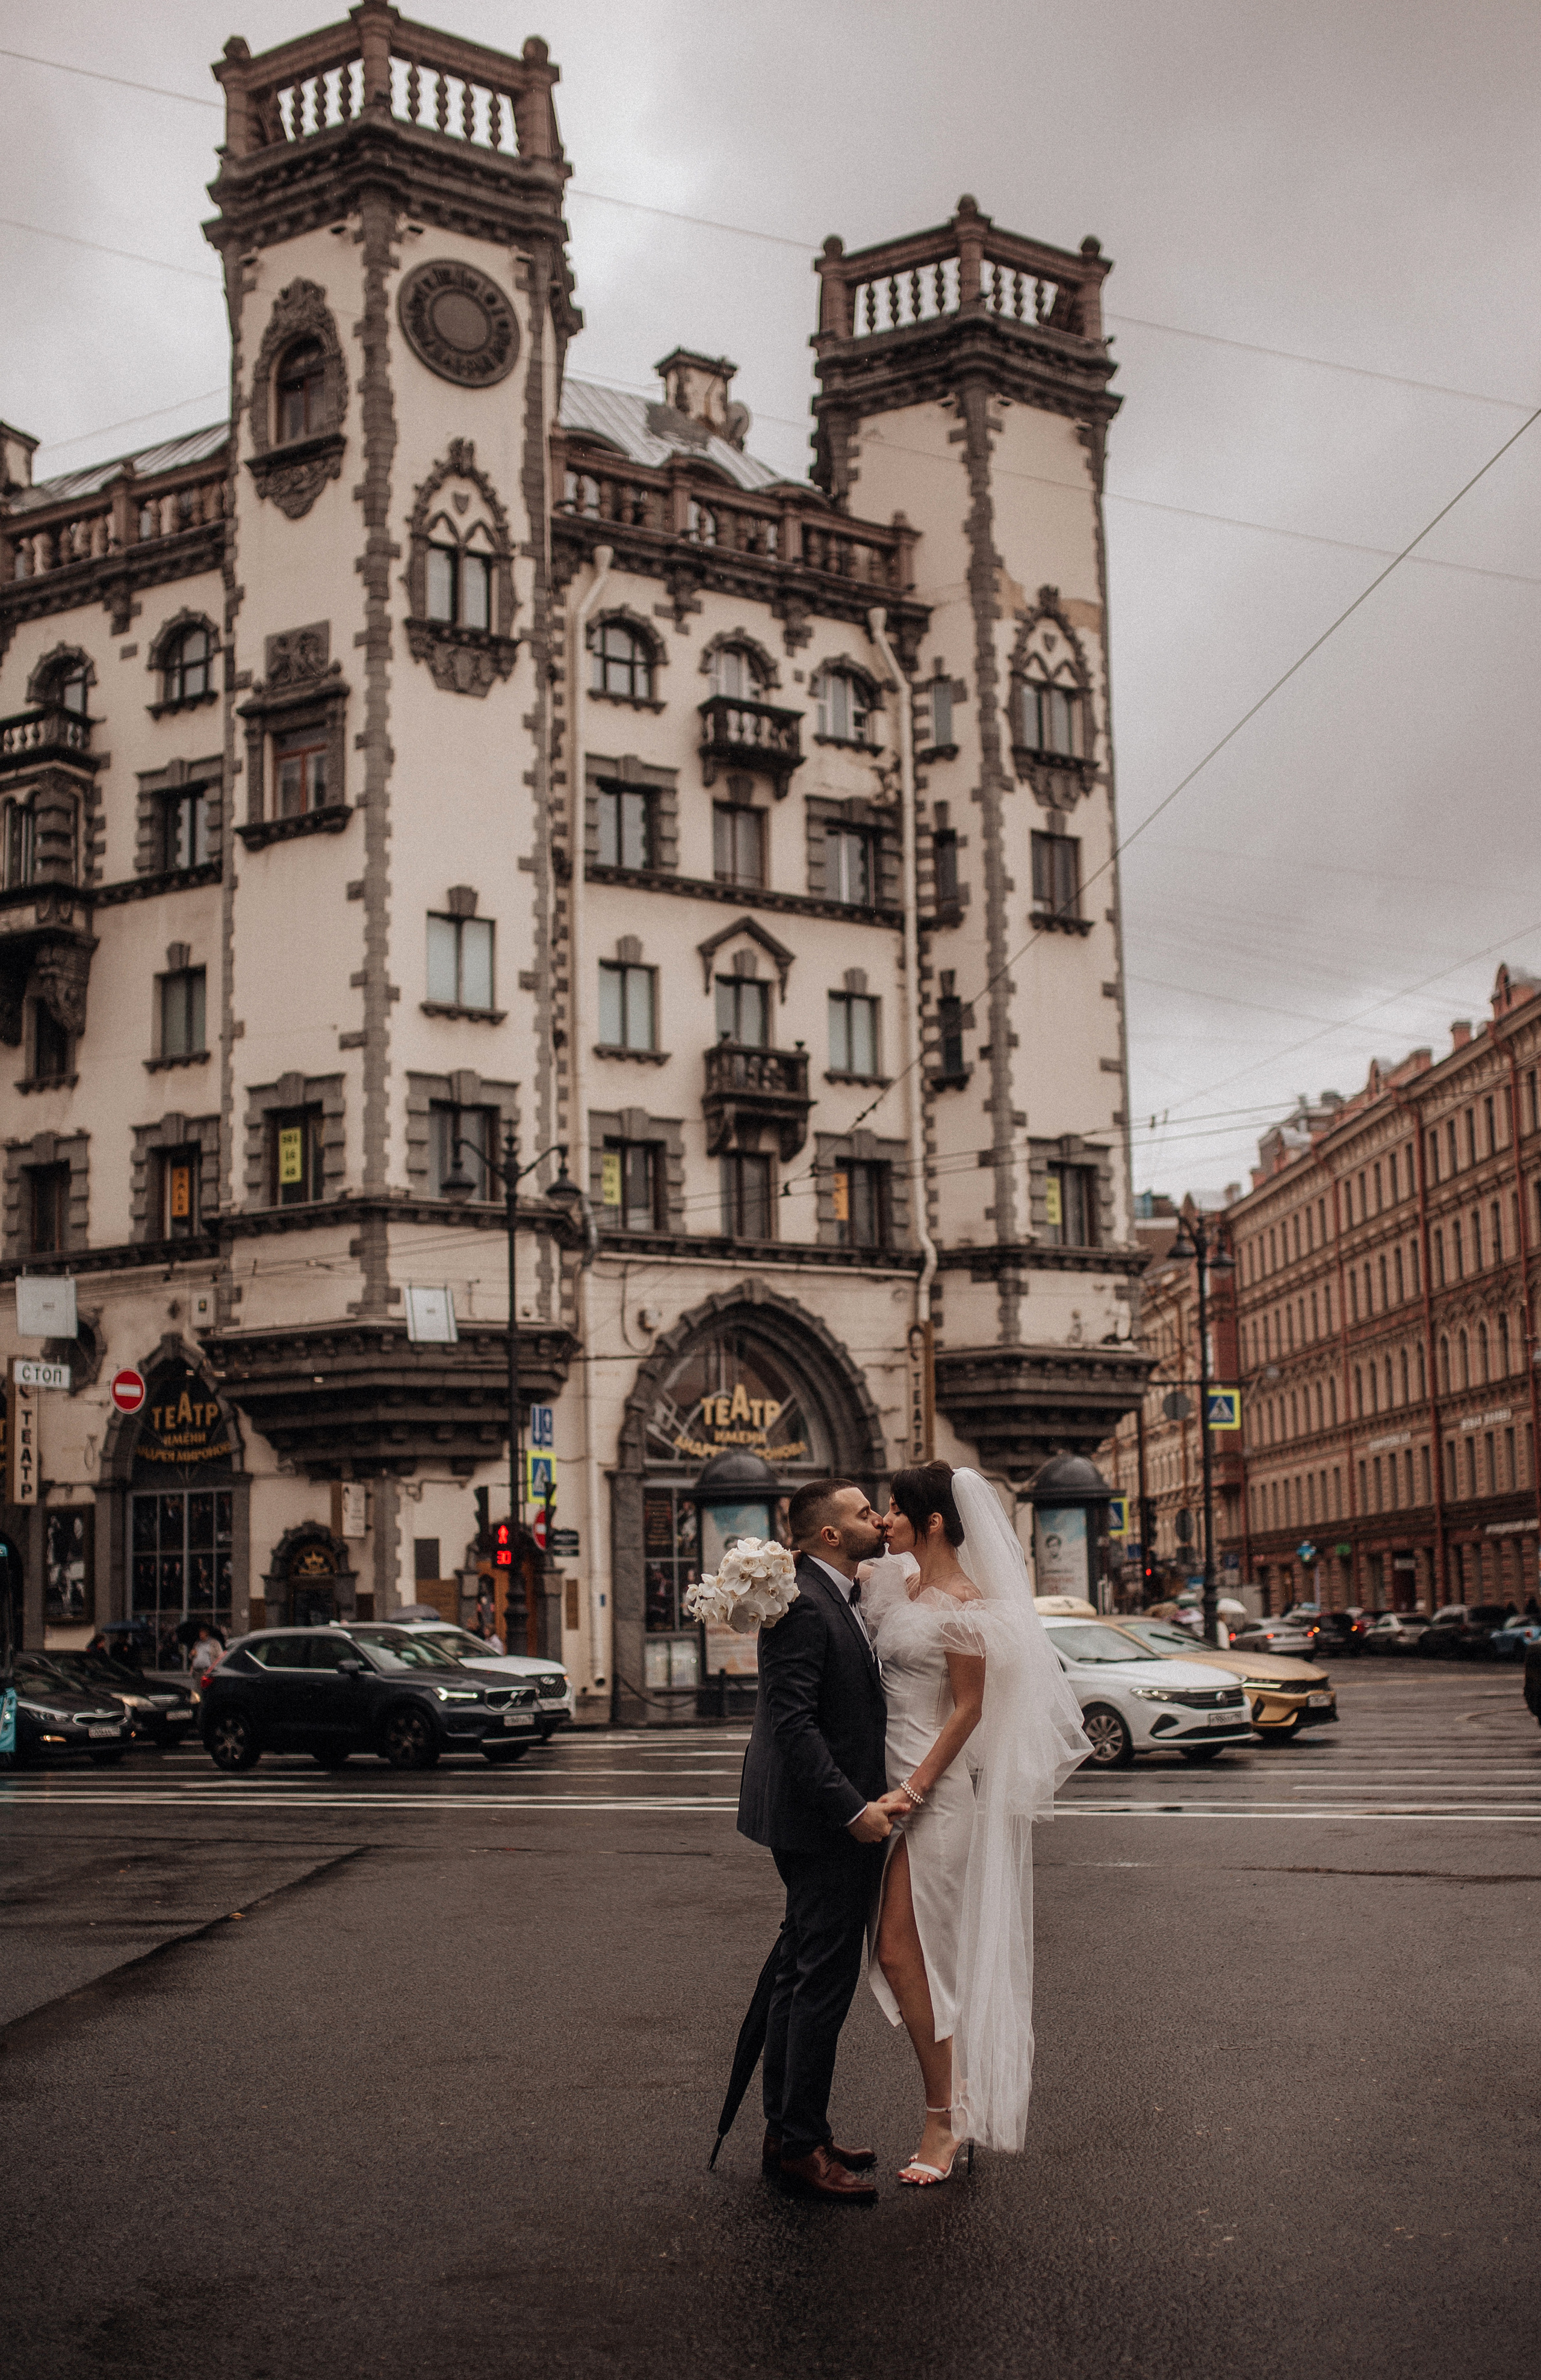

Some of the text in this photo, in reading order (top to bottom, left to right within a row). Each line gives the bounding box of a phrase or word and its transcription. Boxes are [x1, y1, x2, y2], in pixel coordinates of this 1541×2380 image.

[22, 1365, 62, 1383] СТОП
[152, 1391, 219, 1430] ТЕАТР
[700, 1383, 782, 1427] ТЕАТР
[913, 1372, 923, 1456] ТЕАТР
[20, 1409, 33, 1500] ТЕАТР
[497, 1550, 512, 1565] 30
